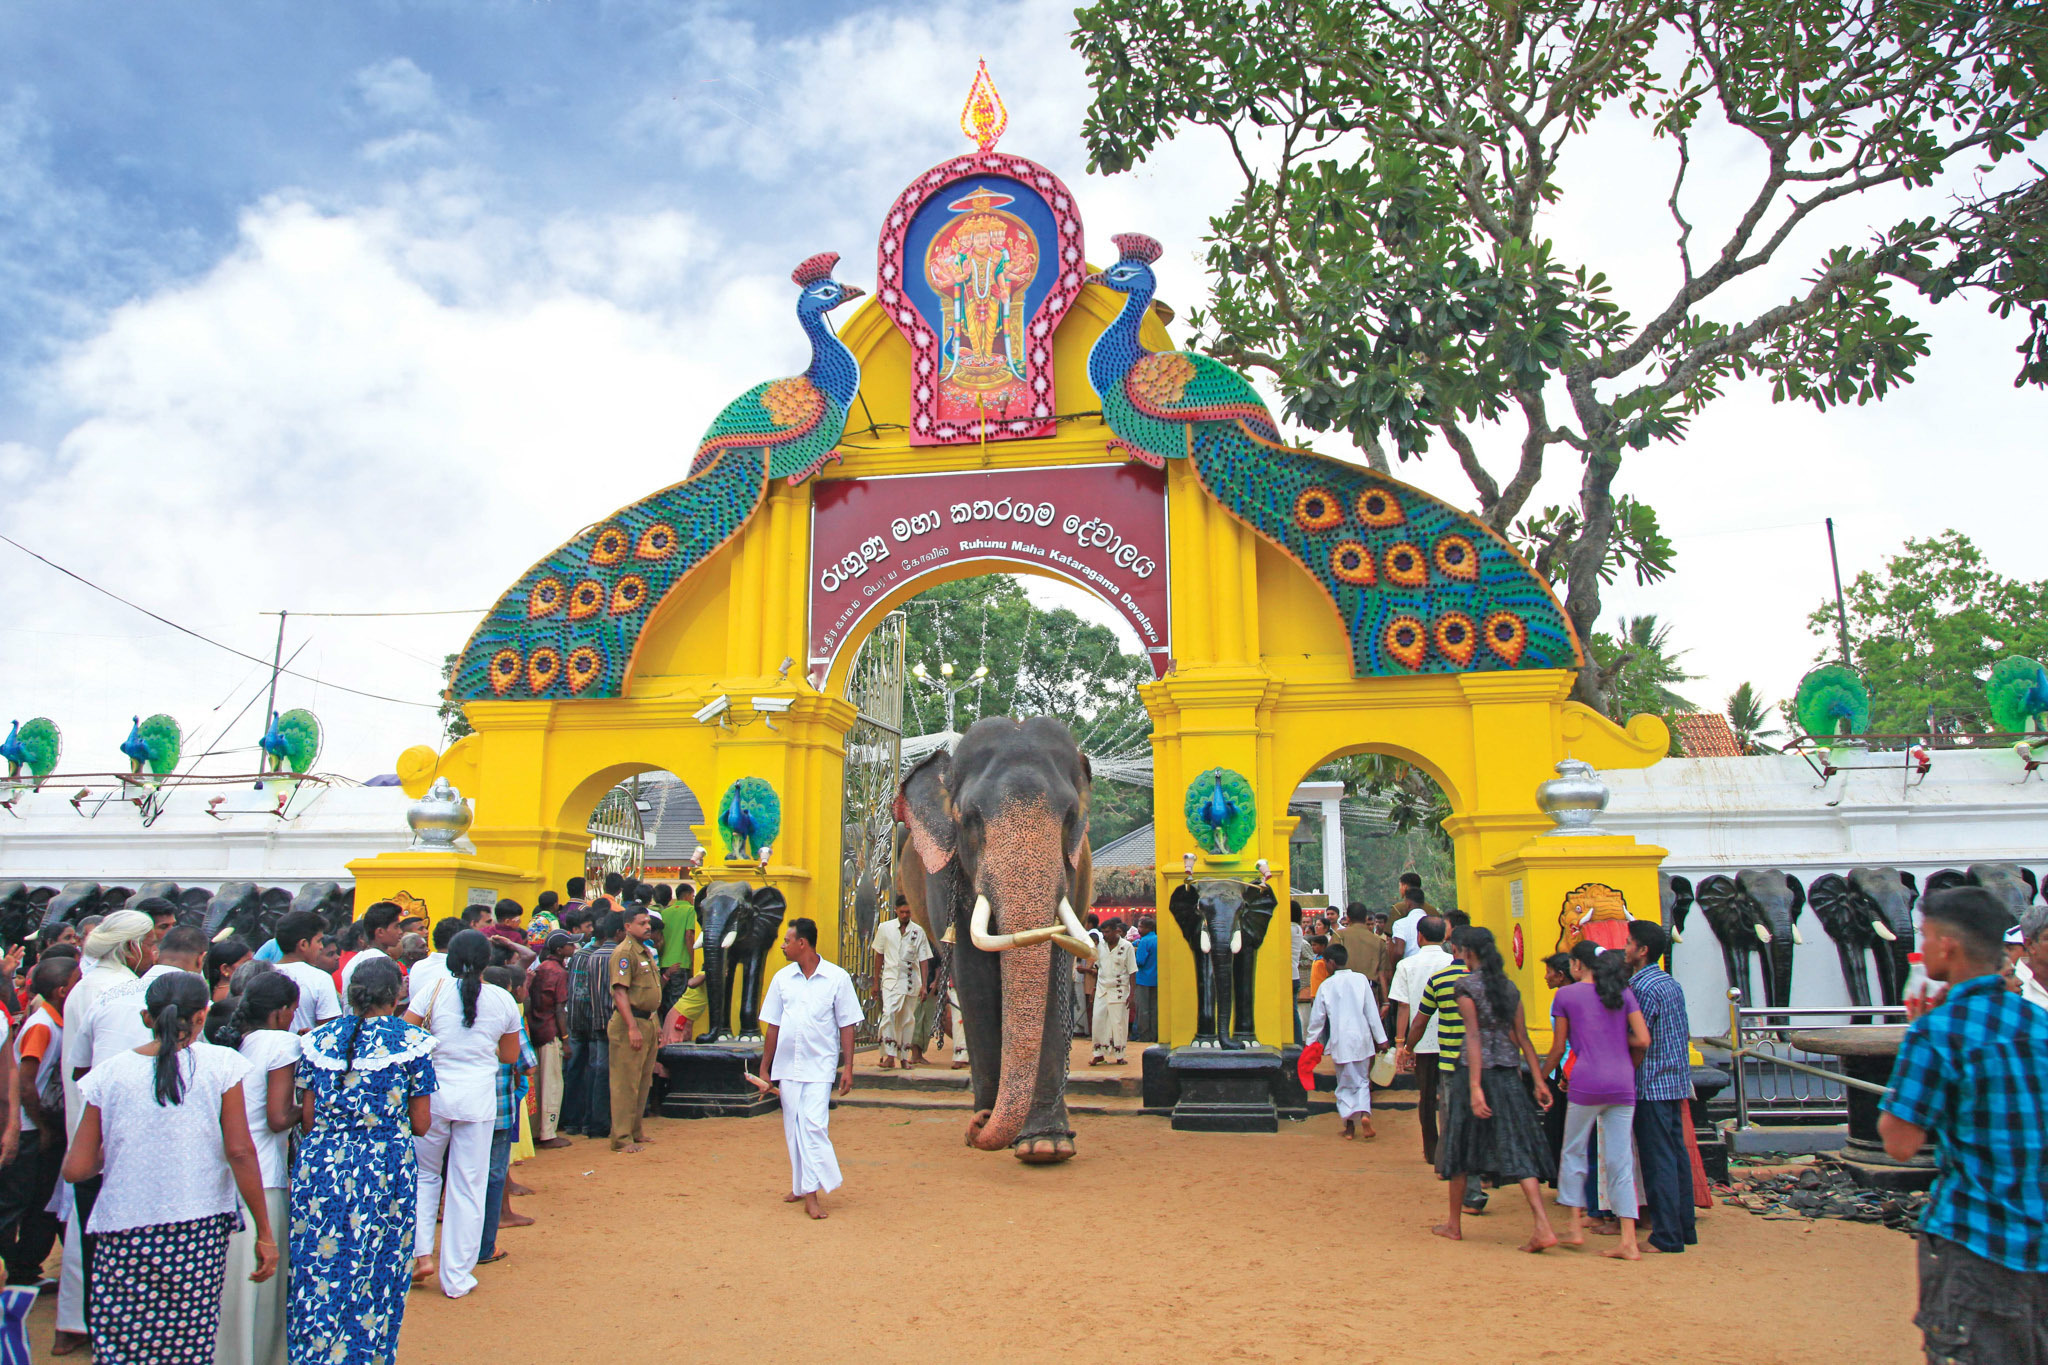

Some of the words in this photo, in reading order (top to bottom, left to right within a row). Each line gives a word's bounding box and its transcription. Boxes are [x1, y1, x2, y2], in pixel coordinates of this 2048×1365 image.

[821, 535, 891, 592] රුහුණු
[891, 509, 941, 542] මහා
[950, 497, 1056, 527] කතරගම
[1063, 514, 1156, 578] දේවාලය
[959, 538, 1007, 551] Ruhunu
[1011, 540, 1046, 557] Maha
[1049, 549, 1120, 595] Kataragama
[1120, 593, 1159, 643] Devalaya
[550, 1113, 556, 1122] 3
